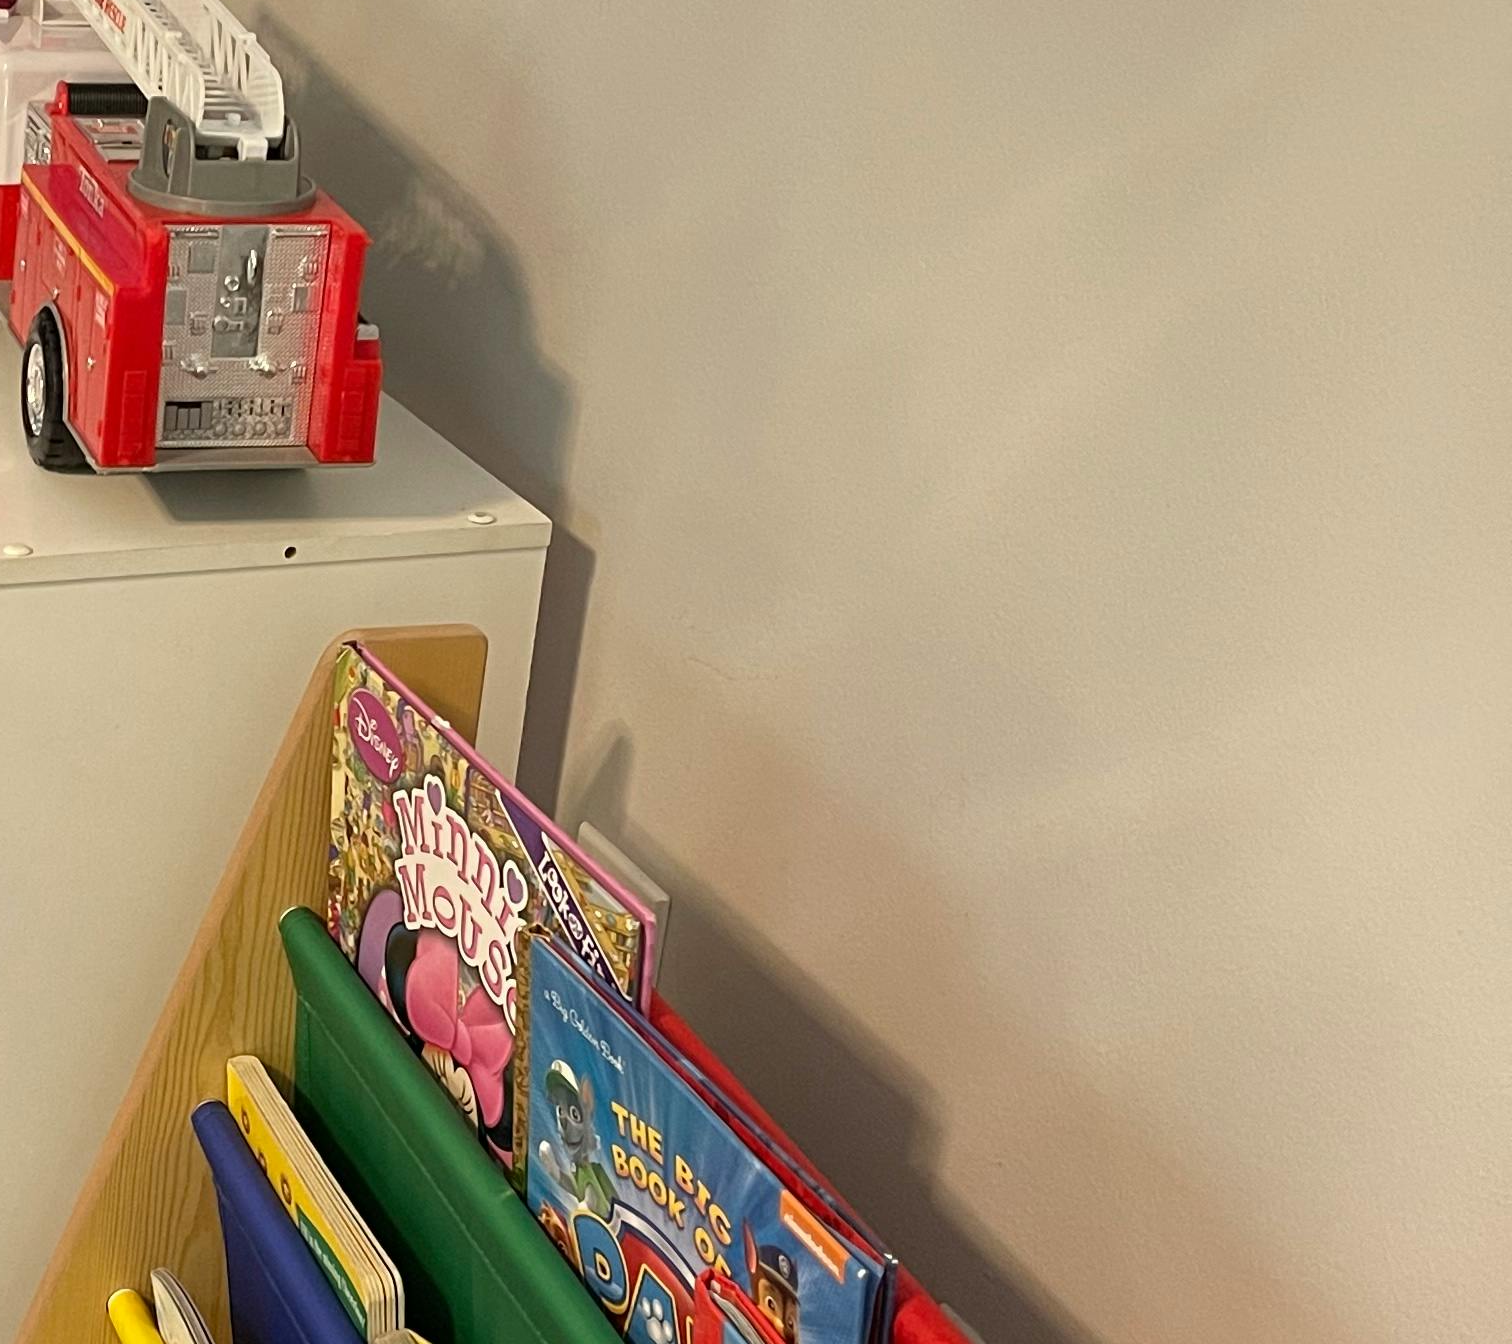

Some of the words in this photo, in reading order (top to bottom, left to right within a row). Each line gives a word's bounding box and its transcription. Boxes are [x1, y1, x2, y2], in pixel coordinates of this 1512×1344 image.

[352, 697, 401, 777] Disney
[395, 780, 525, 940] Minni
[610, 1143, 685, 1229] BOOK
[611, 1100, 663, 1166] THE
[675, 1154, 732, 1246] BIG
